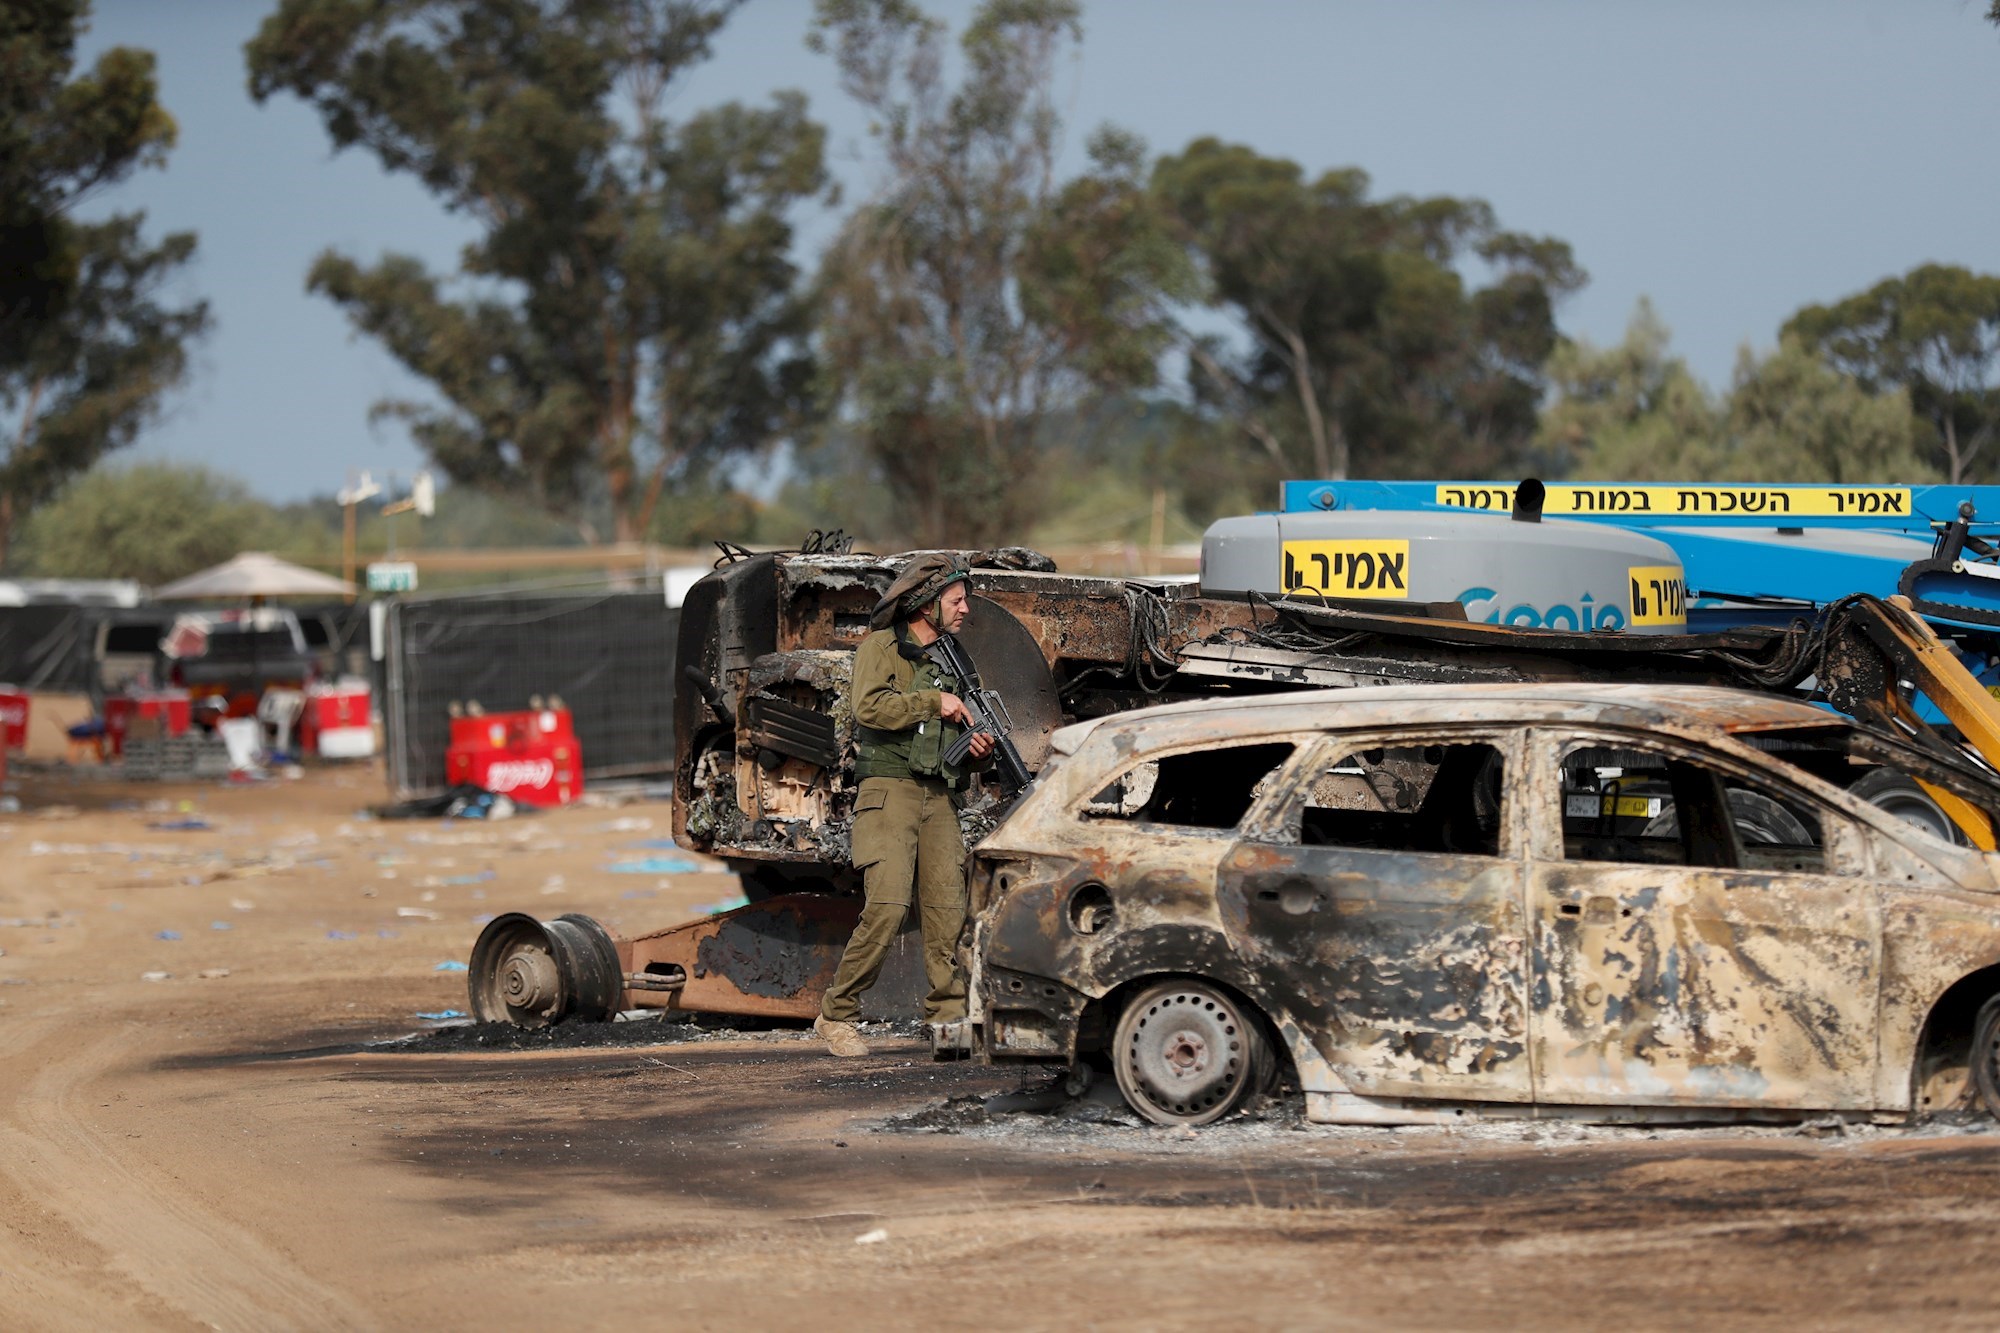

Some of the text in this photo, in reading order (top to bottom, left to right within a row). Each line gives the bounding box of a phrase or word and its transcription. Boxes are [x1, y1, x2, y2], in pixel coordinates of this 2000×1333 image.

[1446, 489, 1902, 512] אמיר השכרת במות רמה
[1311, 552, 1405, 590] אמיר
